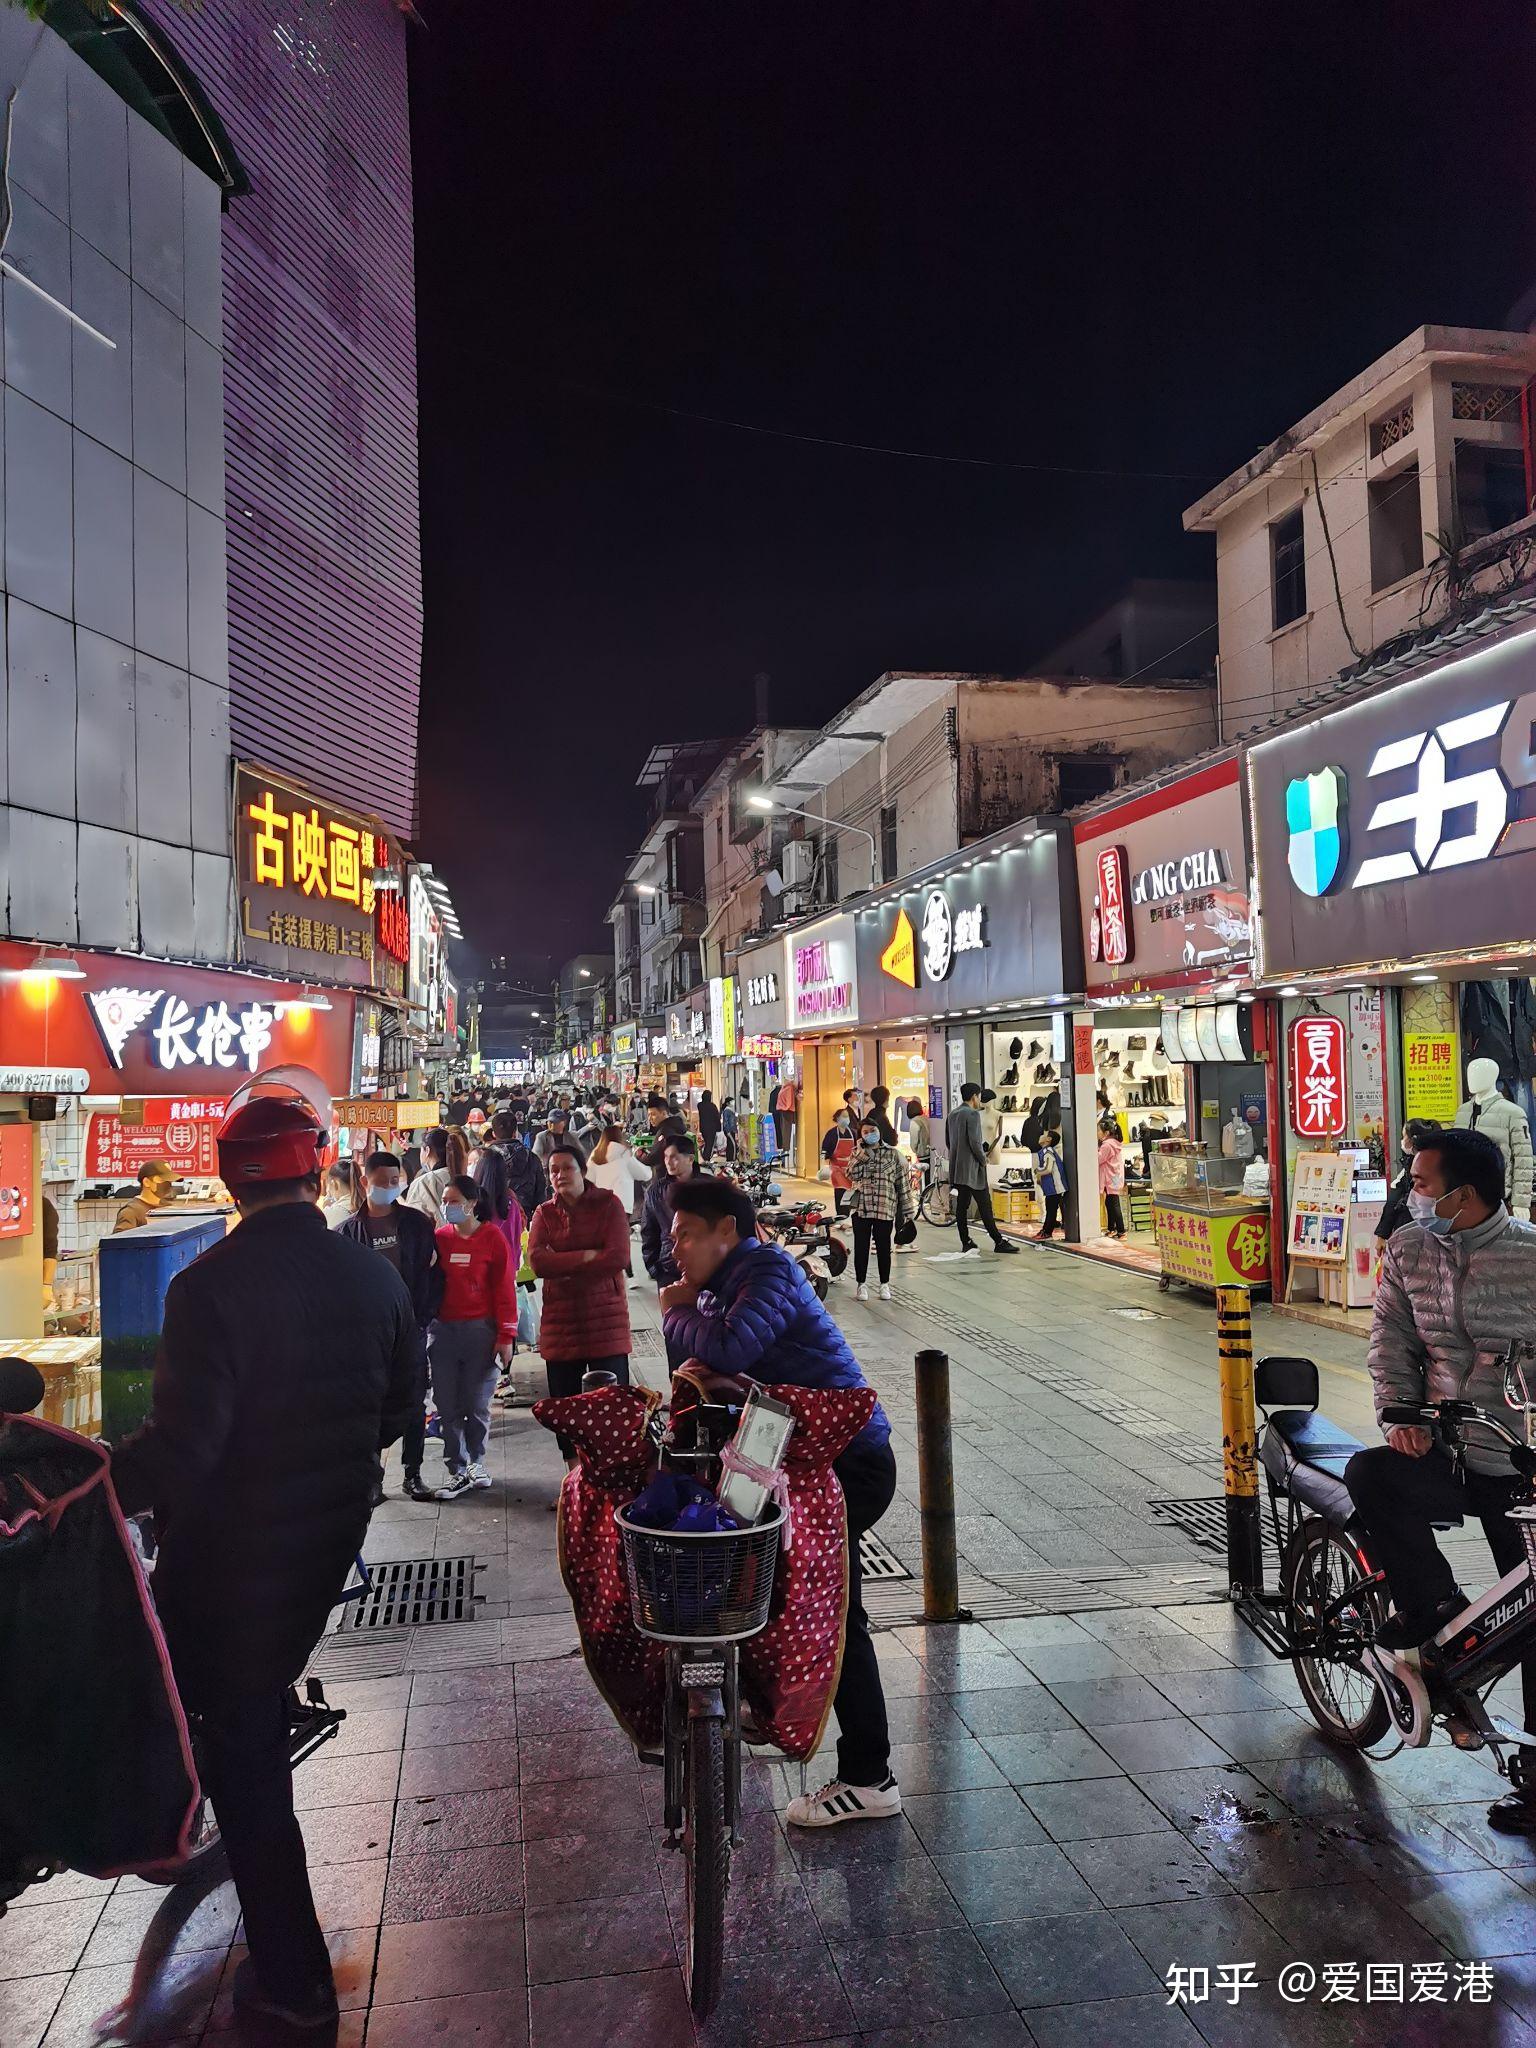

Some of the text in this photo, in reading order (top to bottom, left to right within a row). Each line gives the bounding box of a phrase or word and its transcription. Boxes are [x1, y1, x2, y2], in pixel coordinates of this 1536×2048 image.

[250, 791, 360, 906] 古映画
[1180, 849, 1221, 890] CHA
[361, 830, 375, 914] 摄影
[269, 910, 373, 960] 古装摄影请上三楼
[797, 941, 830, 986] 都市丽人
[798, 983, 850, 1015] COSMO LADY
[153, 995, 273, 1073] 长枪串
[1409, 1043, 1452, 1065] 招聘
[4, 1072, 24, 1086] 400
[26, 1073, 52, 1086] 8277
[124, 1125, 165, 1135] WELCOME
[170, 1101, 225, 1120] 黄金串1-5元
[97, 1119, 111, 1174] 有梦想
[111, 1118, 123, 1174] 有串有肉
[173, 1126, 192, 1147] 串
